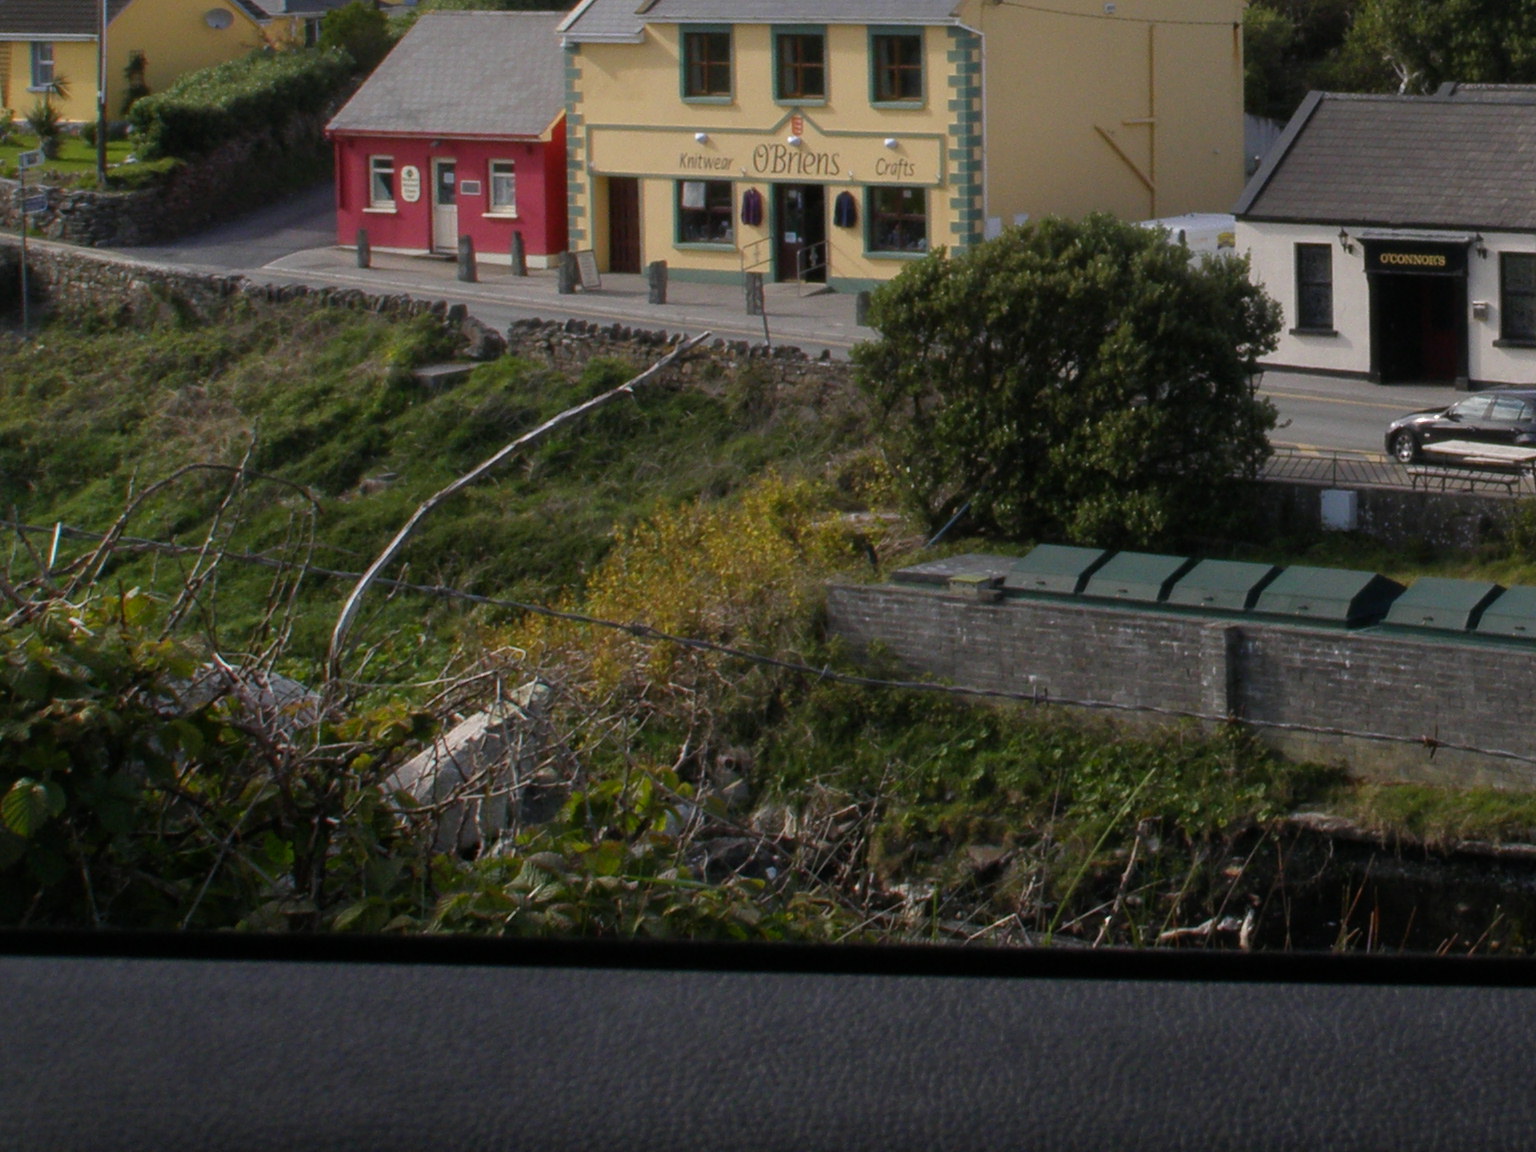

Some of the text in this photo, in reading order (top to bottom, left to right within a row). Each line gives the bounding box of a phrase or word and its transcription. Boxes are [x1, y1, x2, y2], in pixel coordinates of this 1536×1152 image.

[679, 143, 916, 181] Knitwear O'Briens Crafts
[1380, 253, 1446, 266] O'CONNOR'S
